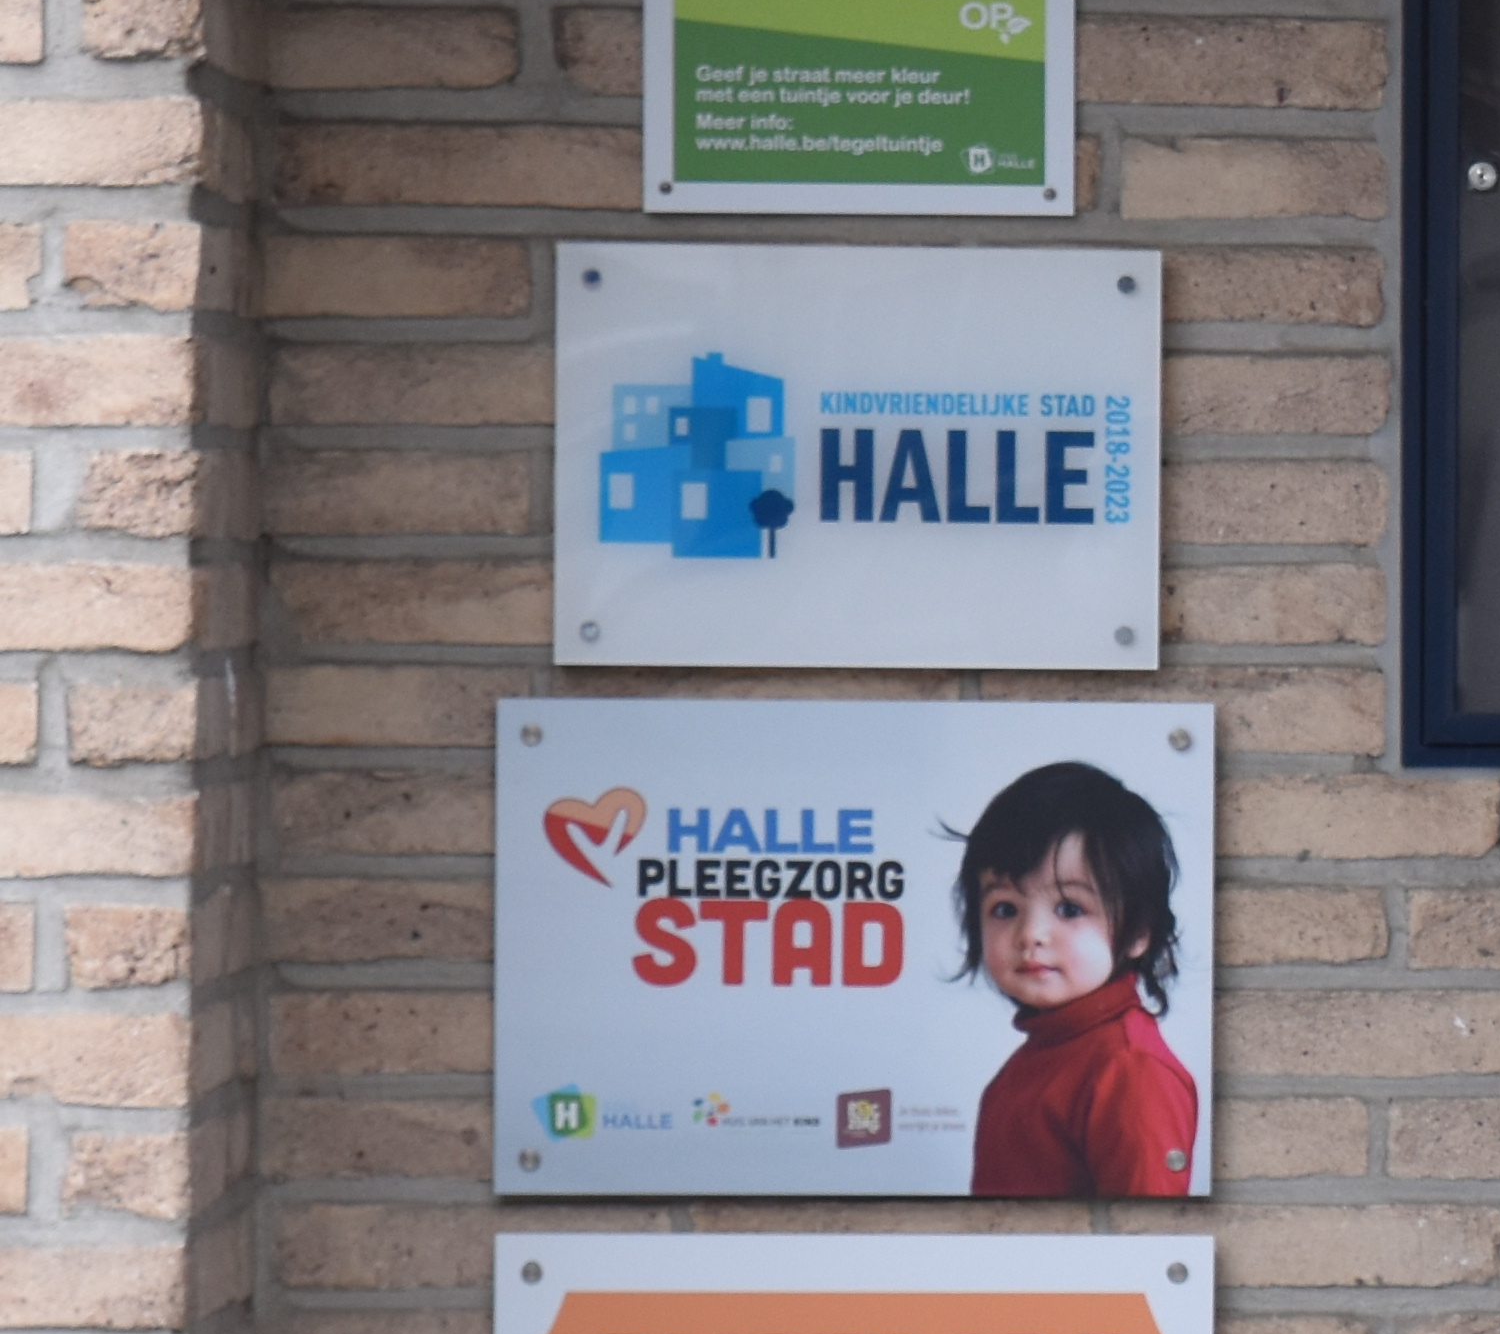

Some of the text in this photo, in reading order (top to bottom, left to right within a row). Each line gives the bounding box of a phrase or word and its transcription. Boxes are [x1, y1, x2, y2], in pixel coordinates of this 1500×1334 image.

[958, 1, 1014, 30] OP
[695, 64, 941, 86] Geef je straat meer kleur
[694, 87, 971, 109] met een tuintje voor je deur!
[694, 113, 794, 131] Meer info:
[694, 135, 944, 157] www.halle.be/tegeltuintje
[819, 391, 1097, 418] KINDVRIENDELIJKE STAD
[1104, 396, 1132, 526] 2018-2023
[819, 427, 1097, 525] HALLE
[666, 807, 874, 855] HALLE
[637, 858, 905, 902] PLEEGZORG
[631, 896, 905, 989] STAD
[602, 1112, 674, 1131] HALLE
